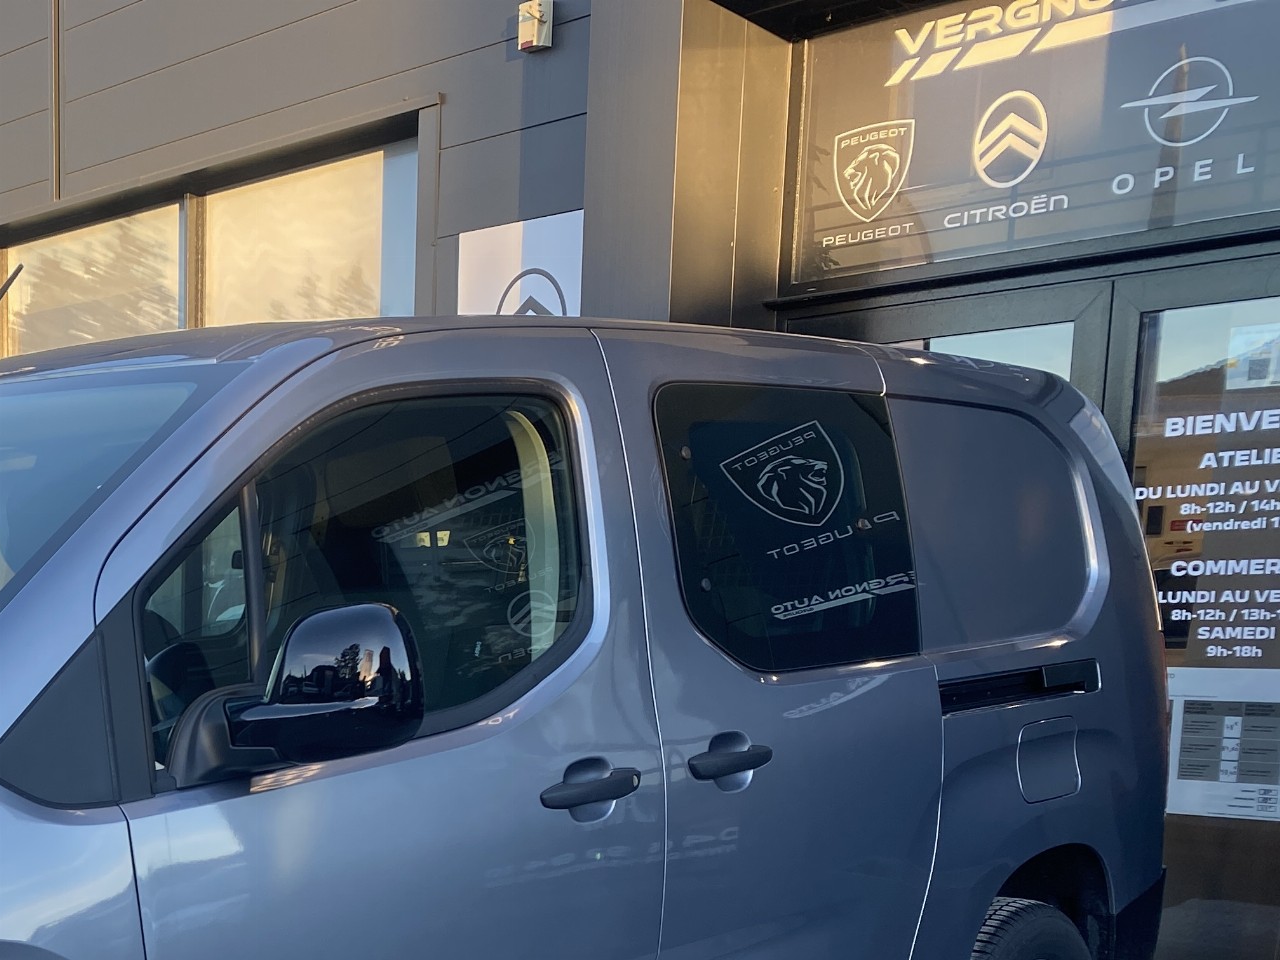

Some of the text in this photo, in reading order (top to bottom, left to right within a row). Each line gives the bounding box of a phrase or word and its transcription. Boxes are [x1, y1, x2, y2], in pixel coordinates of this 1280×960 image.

[840, 127, 907, 149] PEUGEOT
[1112, 153, 1255, 195] OPEL
[943, 194, 1069, 230] CITROËN
[822, 222, 915, 248] PEUGEOT
[1164, 409, 1280, 438] BIENVE
[1134, 486, 1163, 500] DU
[1166, 482, 1226, 498] LUNDI
[1229, 480, 1260, 495] AU
[1179, 502, 1236, 515] 8h-12h
[1238, 500, 1248, 514] /
[1185, 517, 1267, 533] (vendredi
[1170, 558, 1280, 577] COMMER
[1157, 590, 1216, 604] LUNDI
[1219, 590, 1250, 603] AU
[1171, 608, 1226, 621] 8h-12h
[1228, 608, 1238, 622] /
[1197, 626, 1276, 640] SAMEDI
[1206, 645, 1263, 658] 9h-18h
